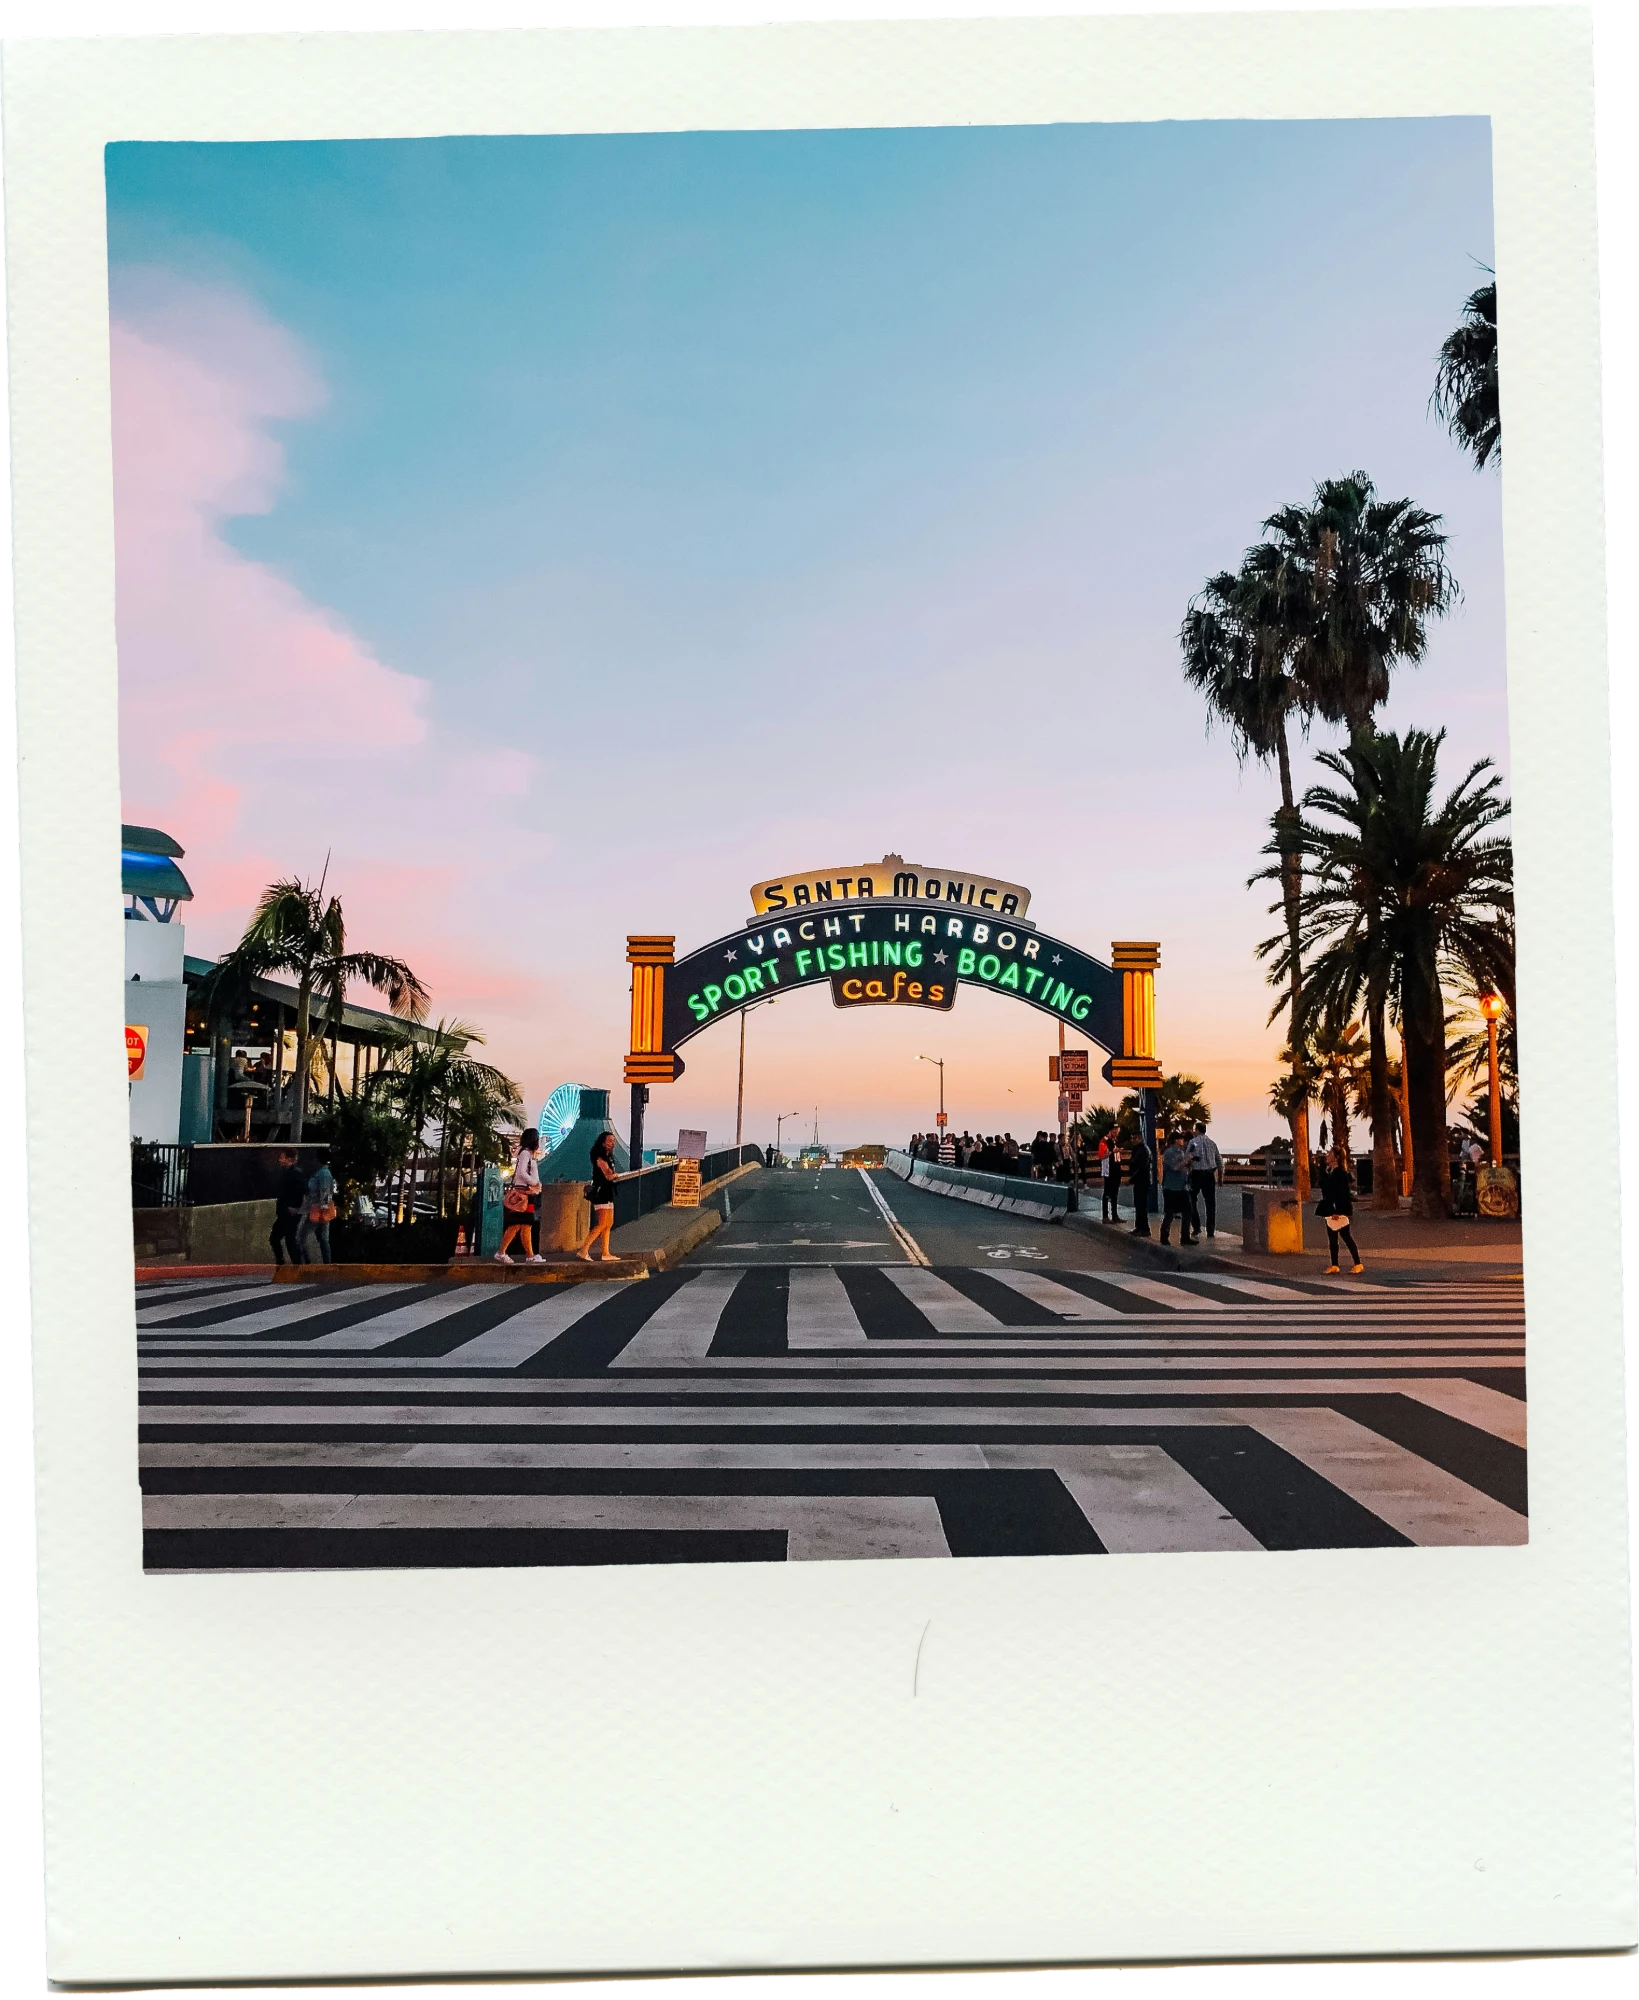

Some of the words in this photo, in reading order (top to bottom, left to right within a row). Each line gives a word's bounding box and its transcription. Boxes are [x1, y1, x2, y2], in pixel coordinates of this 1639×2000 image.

[764, 877, 875, 912] SANTA
[893, 872, 1020, 916] MONICA
[747, 914, 866, 956] YACHT
[894, 914, 1041, 960] HARBOR
[687, 957, 780, 1021] SPORT
[795, 940, 924, 977] FISHING
[957, 947, 1093, 1020] BOATING
[126, 1037, 139, 1046] OT
